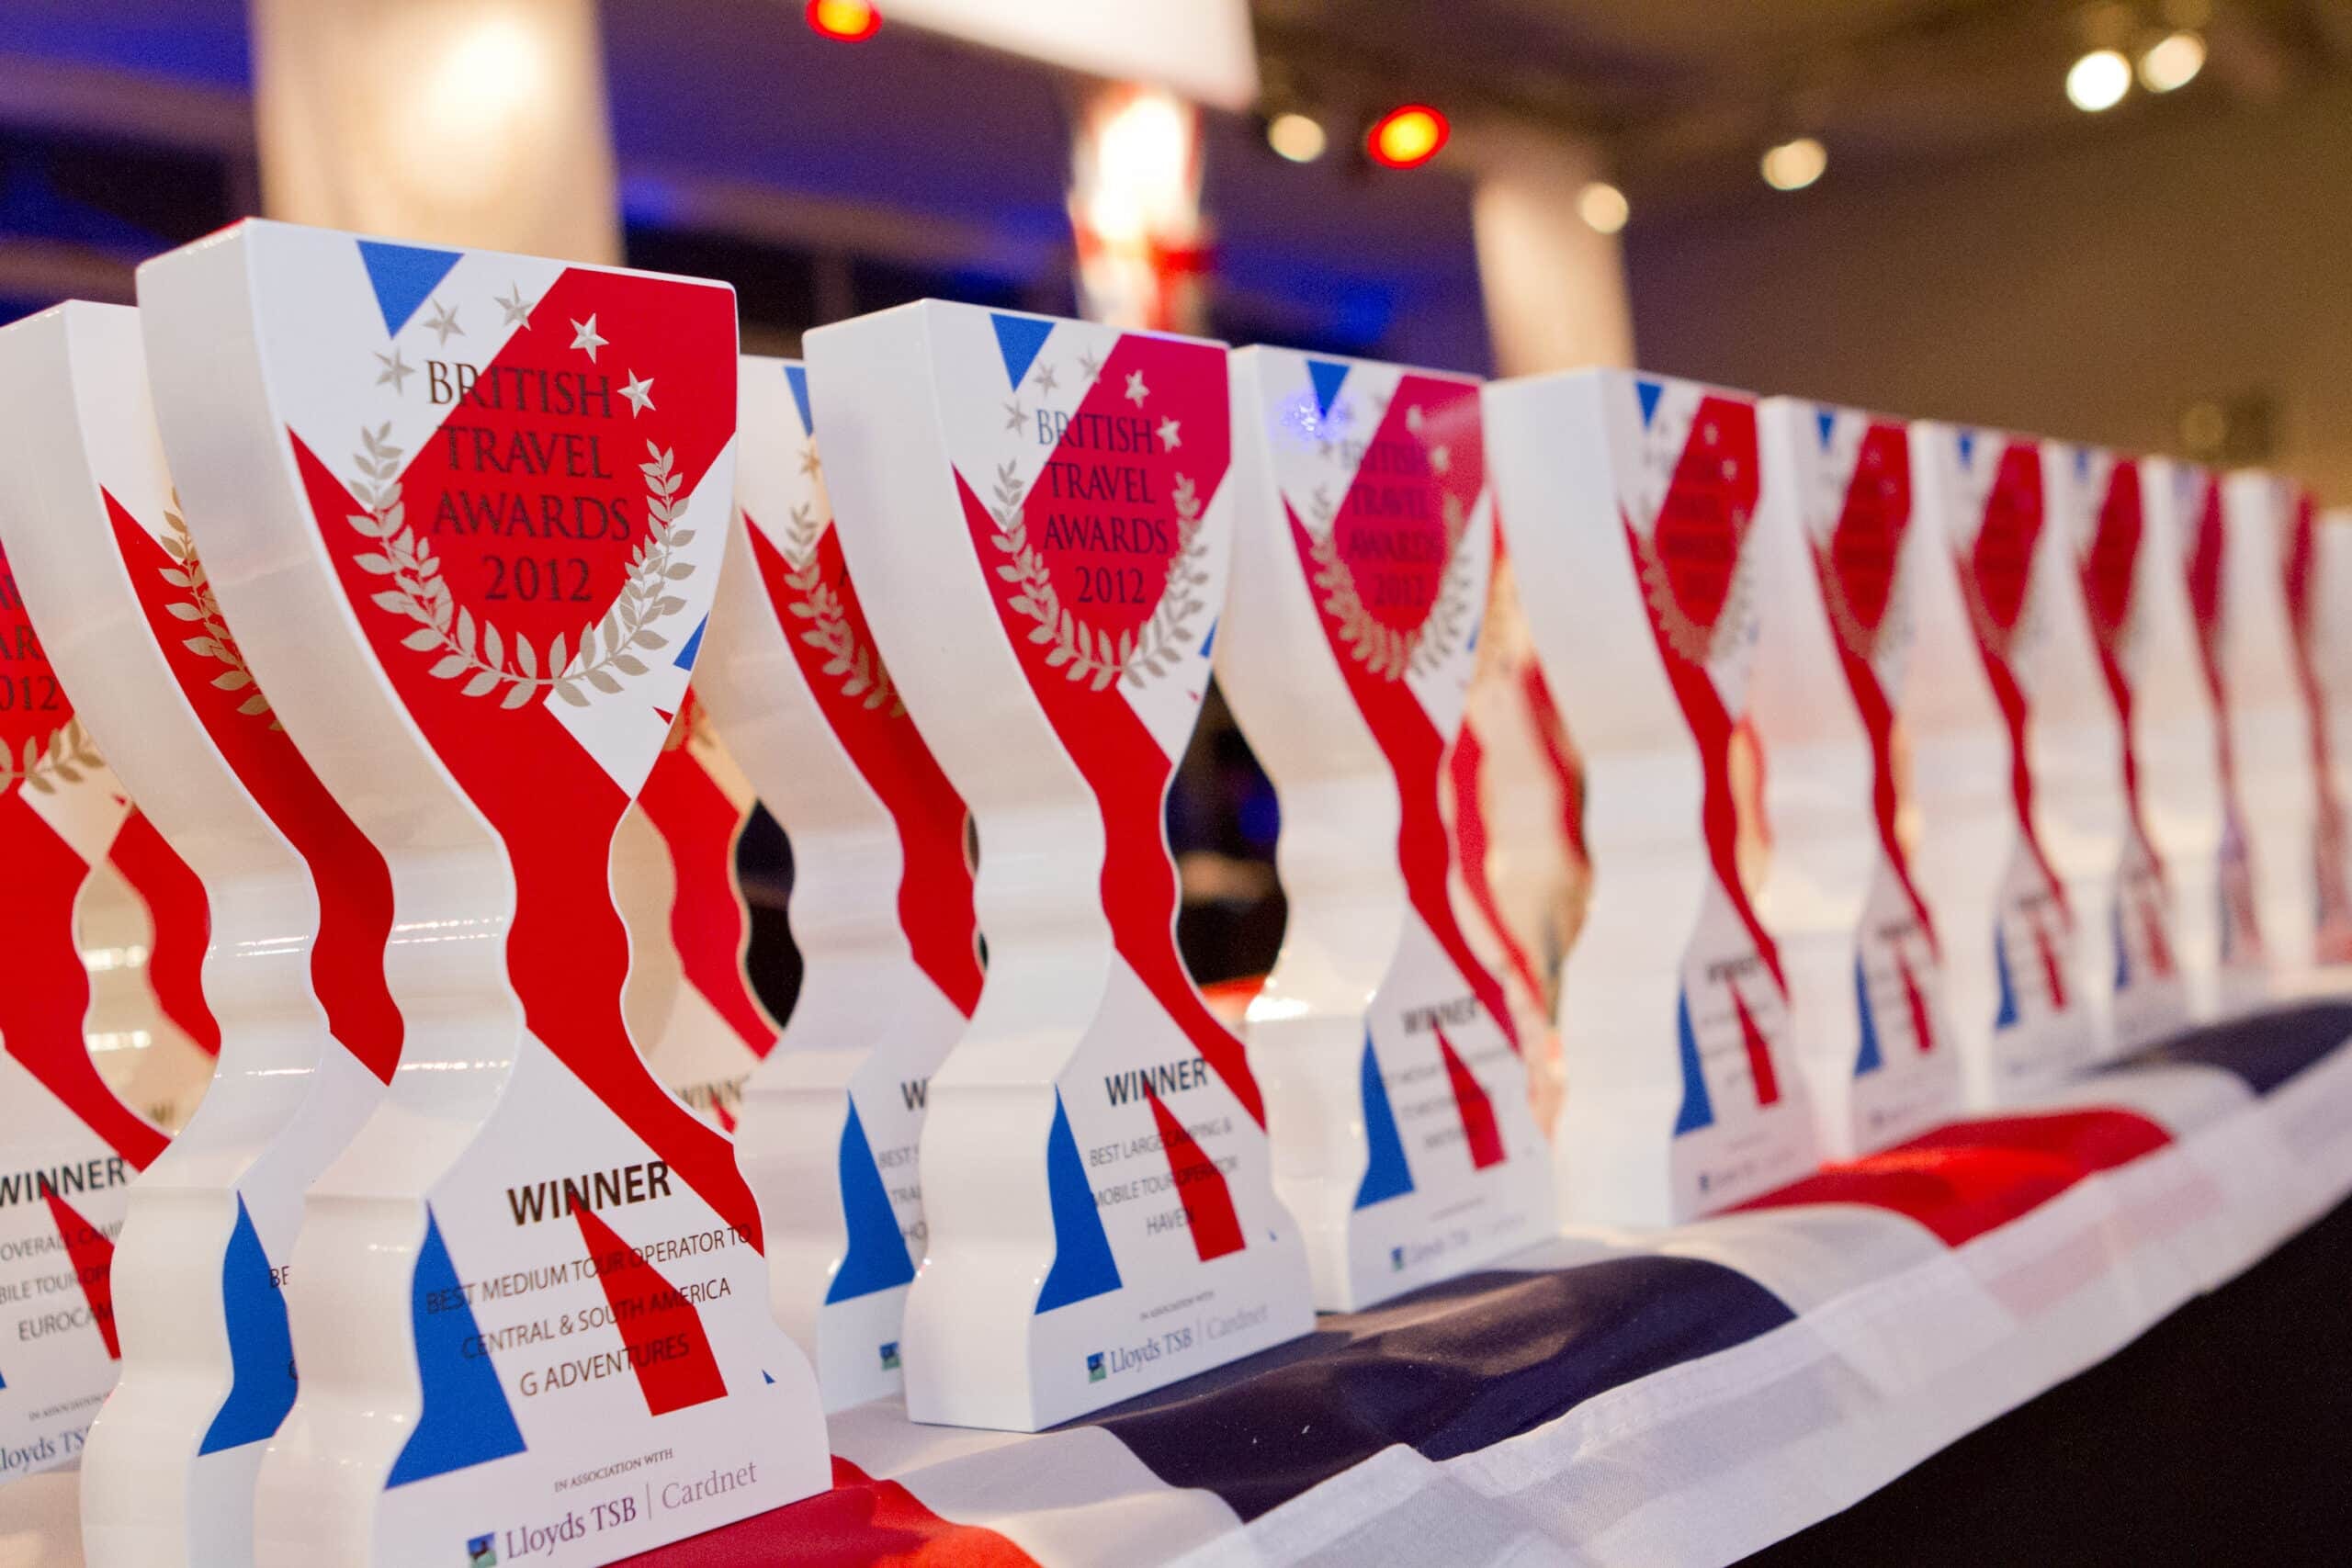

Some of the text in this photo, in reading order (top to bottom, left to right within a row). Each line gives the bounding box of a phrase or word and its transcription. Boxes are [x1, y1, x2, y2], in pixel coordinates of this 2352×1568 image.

[426, 359, 614, 419] BRITISH
[437, 424, 614, 479] TRAVEL
[1036, 409, 1154, 454] BRITISH
[1044, 461, 1158, 504] TRAVEL
[433, 491, 632, 542] AWARDS
[1043, 513, 1170, 555] AWARDS
[484, 556, 593, 602] 2012
[1075, 565, 1147, 604] 2012
[0, 674, 60, 711] 012
[1104, 1057, 1209, 1107] WINNER
[1090, 1144, 1120, 1168] BEST
[1123, 1133, 1163, 1159] LARGE
[0, 1156, 127, 1209] WINNER
[506, 1160, 673, 1226] WINNER
[1091, 1179, 1140, 1207] MOBILE
[1141, 1172, 1174, 1195] TOUR
[1146, 1205, 1196, 1235] HAVEN
[0, 1232, 75, 1262] OVERALL
[426, 1223, 752, 1314] BEST MEDIUM TOUR OPERATOR TO
[0, 1280, 32, 1305] BILE
[36, 1270, 78, 1295] TOUR
[17, 1302, 114, 1342] EUROCAM
[462, 1277, 731, 1359] CENTRAL & SOUTH AMERICA
[520, 1333, 690, 1397] G ADVENTURES
[1110, 1337, 1161, 1374] Lloyds
[1163, 1326, 1193, 1356] TSB
[0, 1436, 56, 1473] loyds
[553, 1448, 674, 1493] IN ASSOCIATION WITH
[506, 1461, 758, 1560] Lloyds TSB Cardnet
